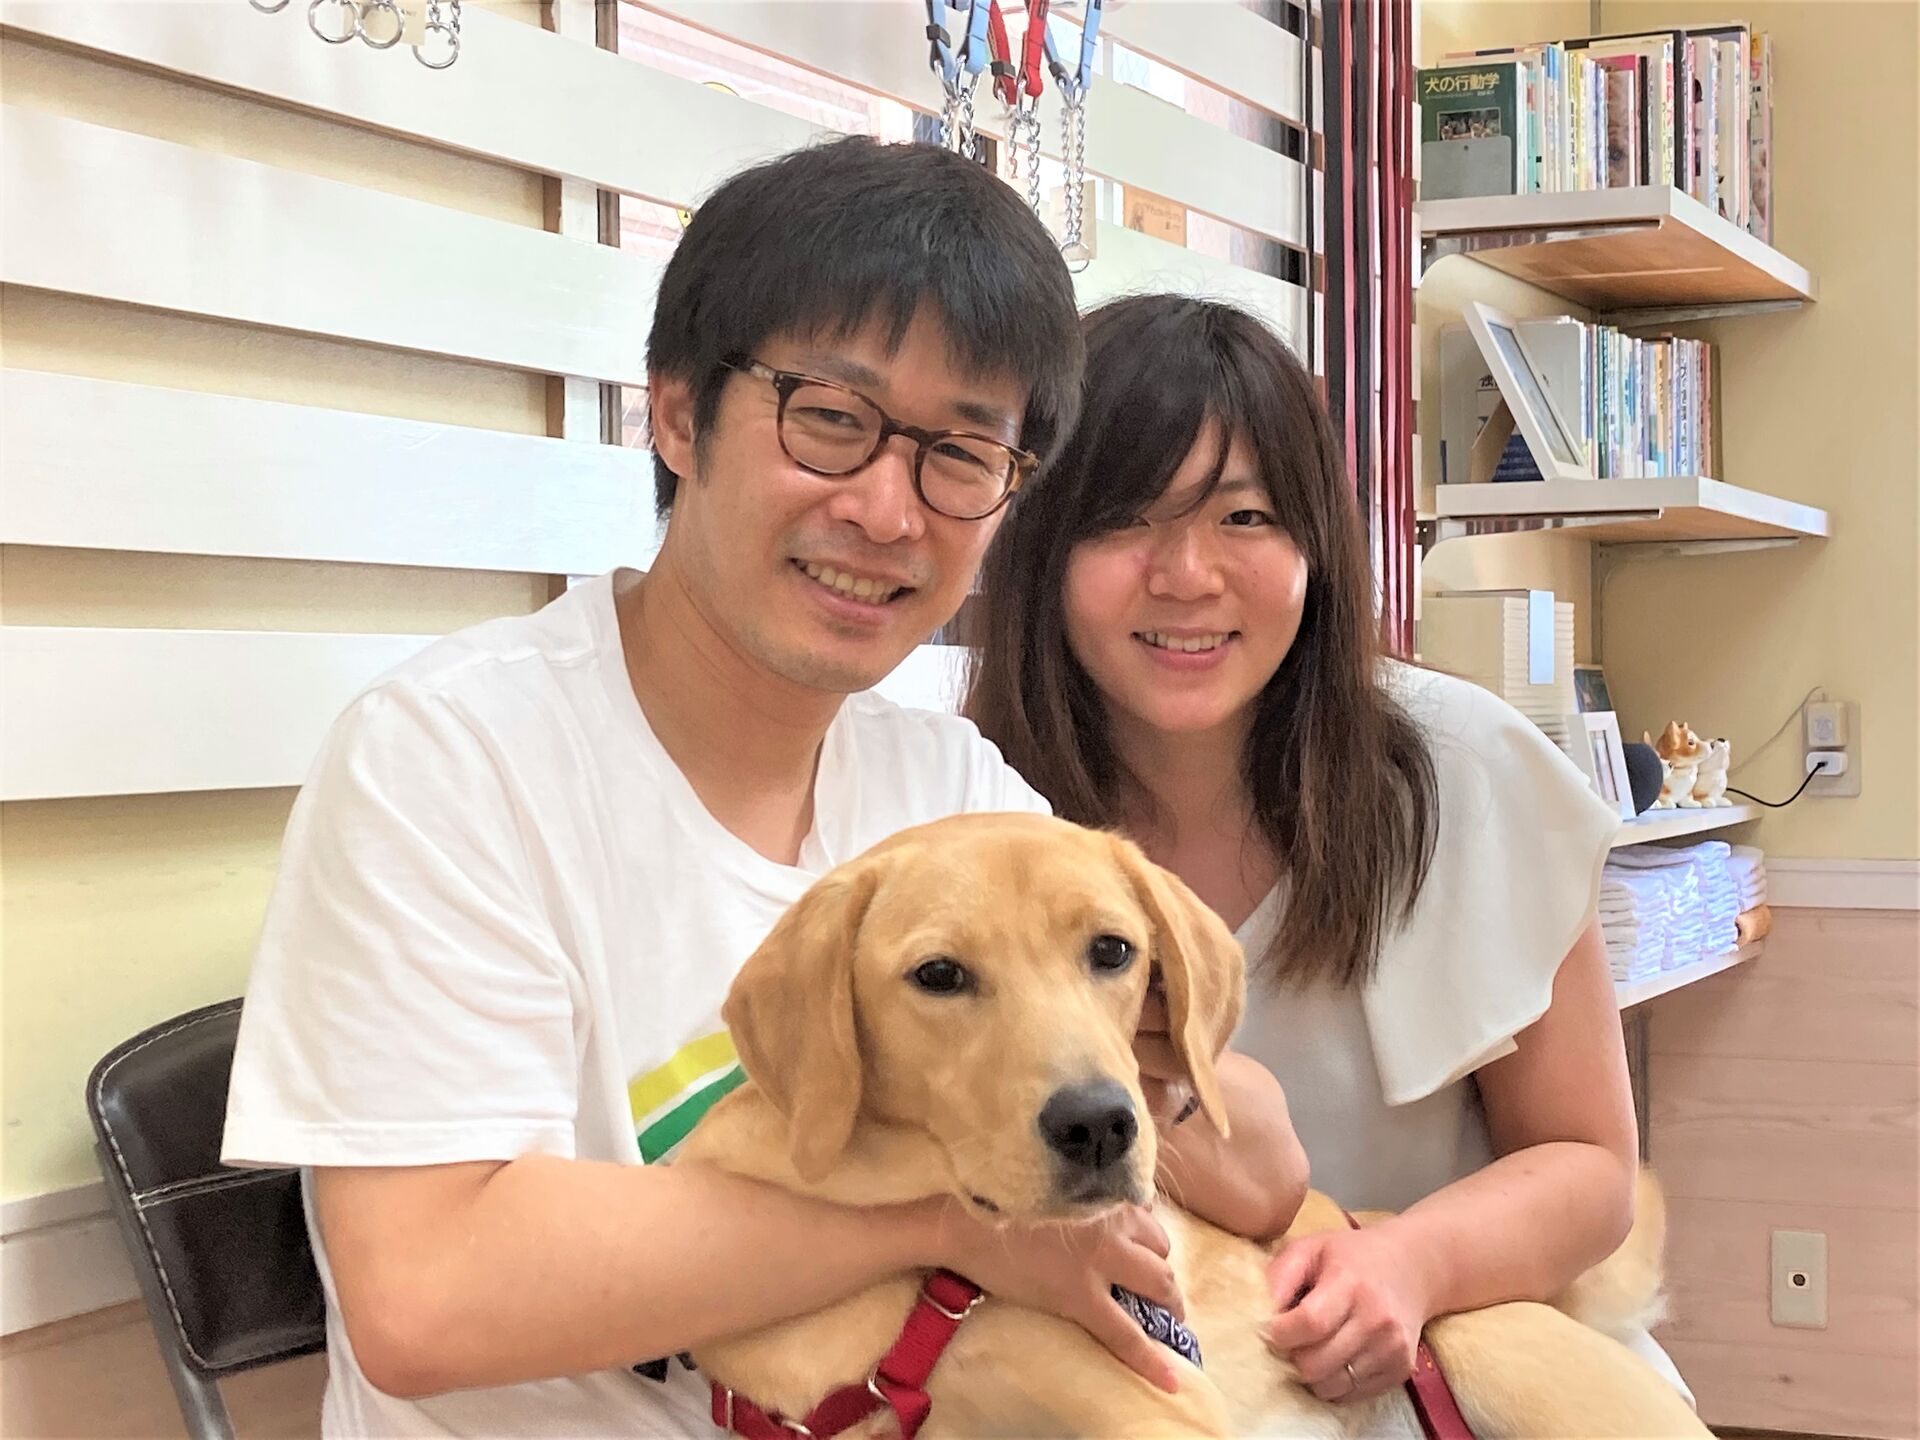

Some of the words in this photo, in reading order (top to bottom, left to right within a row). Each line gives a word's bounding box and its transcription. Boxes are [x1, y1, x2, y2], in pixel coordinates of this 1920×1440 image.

[1424, 72, 1500, 94] 犬の行動学
